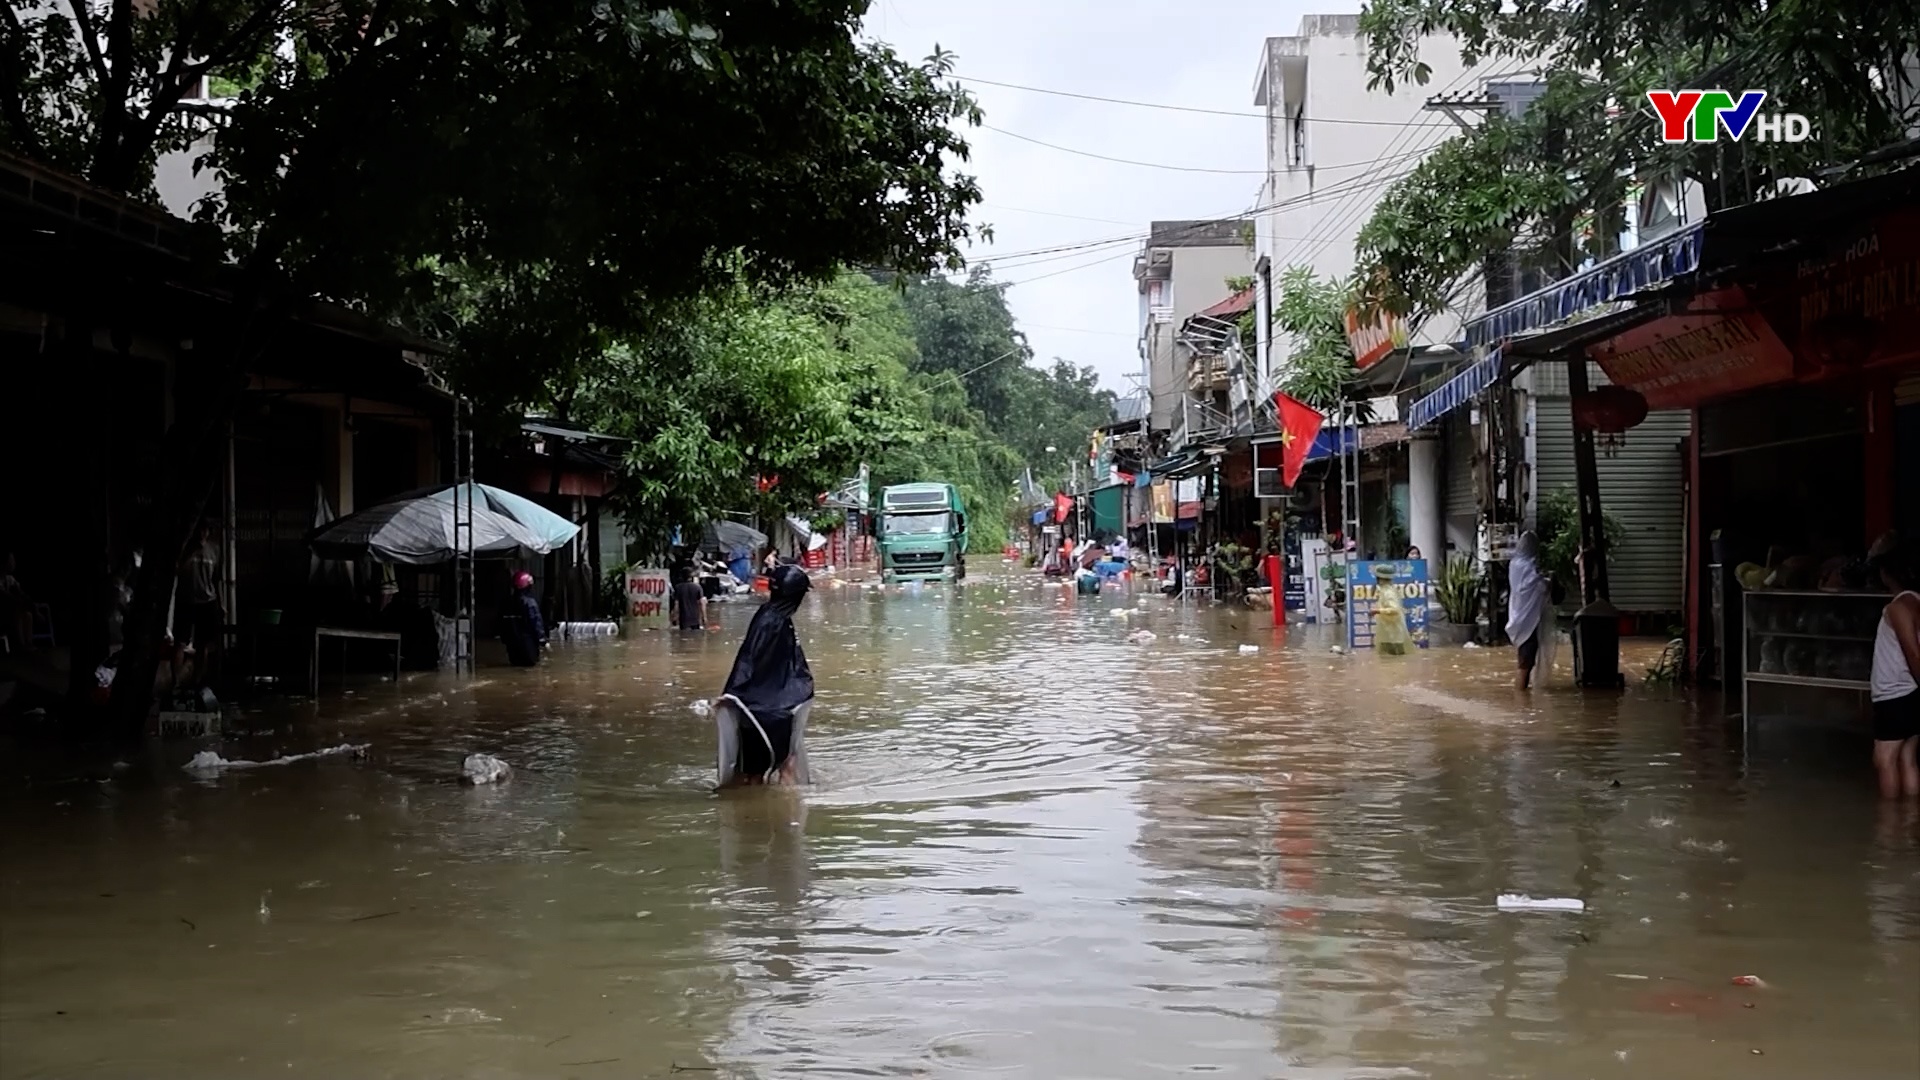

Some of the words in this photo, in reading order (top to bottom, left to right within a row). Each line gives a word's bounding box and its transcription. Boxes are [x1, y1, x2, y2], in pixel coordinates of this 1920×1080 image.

[629, 578, 666, 596] PHOTO
[1352, 583, 1382, 600] BIA
[632, 601, 662, 617] COPY
